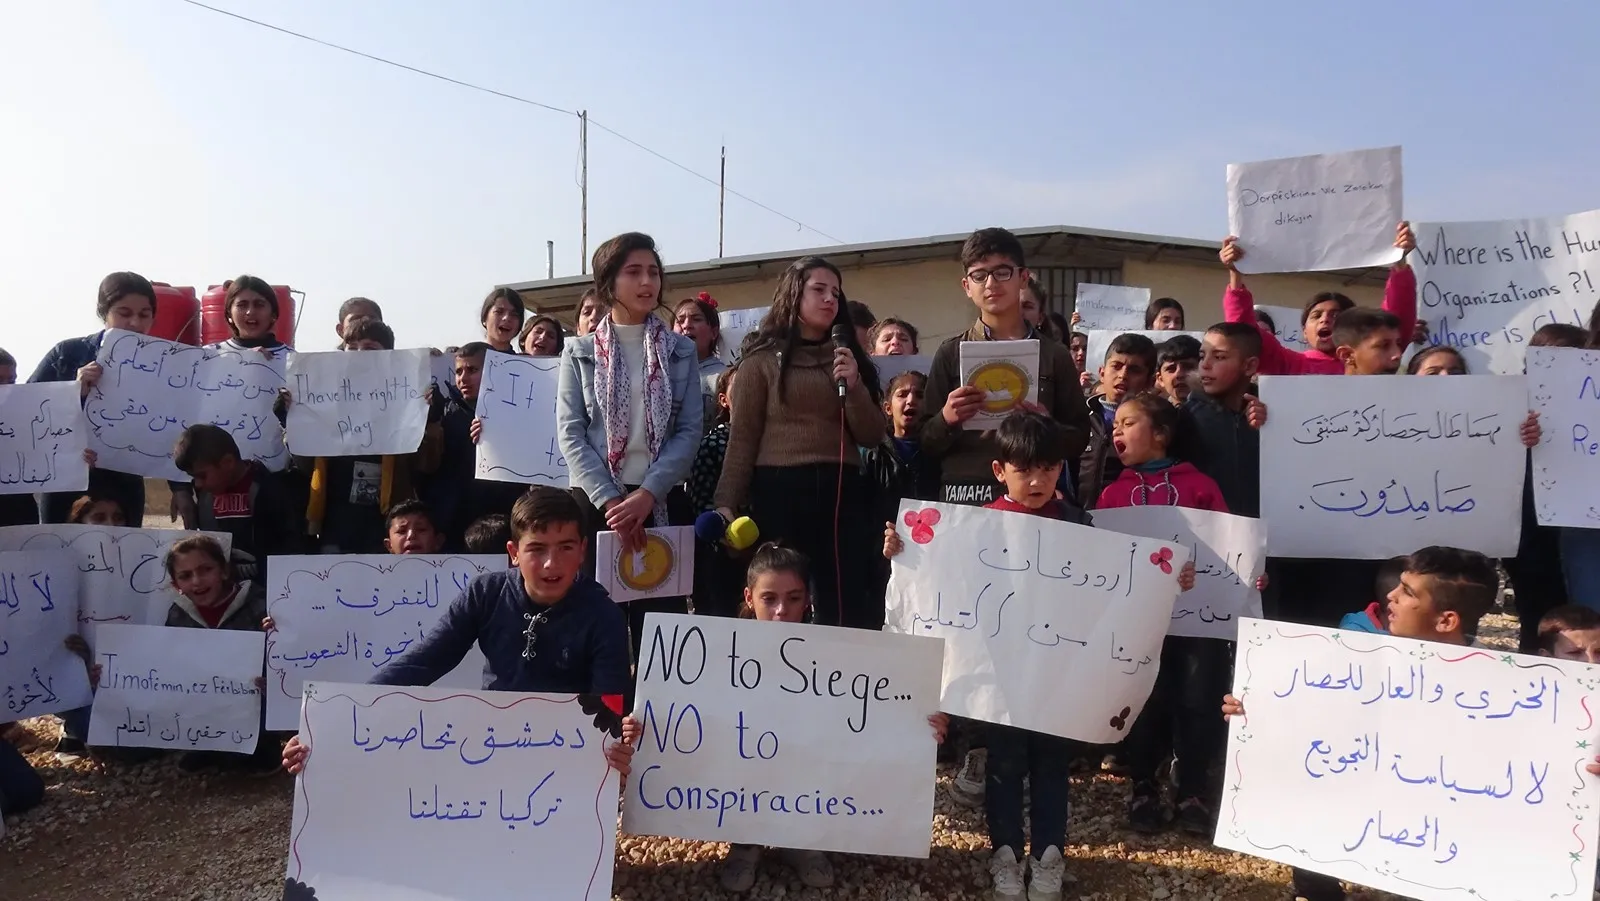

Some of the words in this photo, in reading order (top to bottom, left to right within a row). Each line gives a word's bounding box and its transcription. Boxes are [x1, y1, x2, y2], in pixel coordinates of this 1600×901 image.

[1416, 226, 1488, 266] Where
[1494, 246, 1514, 263] is
[1515, 230, 1555, 261] the
[1562, 231, 1600, 255] Hu
[1422, 280, 1562, 320] Organizations
[1504, 326, 1524, 344] is
[116, 347, 168, 388] أتعلم
[167, 361, 200, 389] أن
[197, 374, 245, 397] حقي
[243, 383, 277, 400] من
[305, 373, 341, 405] have
[340, 378, 362, 402] the
[369, 376, 401, 412] right
[401, 376, 420, 401] to
[501, 372, 534, 409] It
[945, 484, 993, 502] YAMAHA
[977, 528, 1137, 597] أردوغان
[336, 573, 440, 617] للتفرقة
[1026, 622, 1088, 646] من
[643, 623, 708, 686] NO
[727, 630, 762, 690] to
[779, 637, 913, 733] Siege...
[1273, 659, 1364, 699] للحصار
[160, 712, 181, 743] أن
[187, 725, 228, 746] حقي
[459, 721, 586, 765] دمشق
[635, 698, 704, 755] NO
[735, 710, 779, 760] to
[1304, 731, 1381, 779] التجويع
[638, 765, 885, 828] Conspiracies...
[1390, 753, 1514, 802] لسياسة
[1523, 761, 1550, 805] لا
[408, 783, 487, 821] تقتلنا
[499, 770, 563, 831] تركيا
[1342, 809, 1459, 864] والحصار
